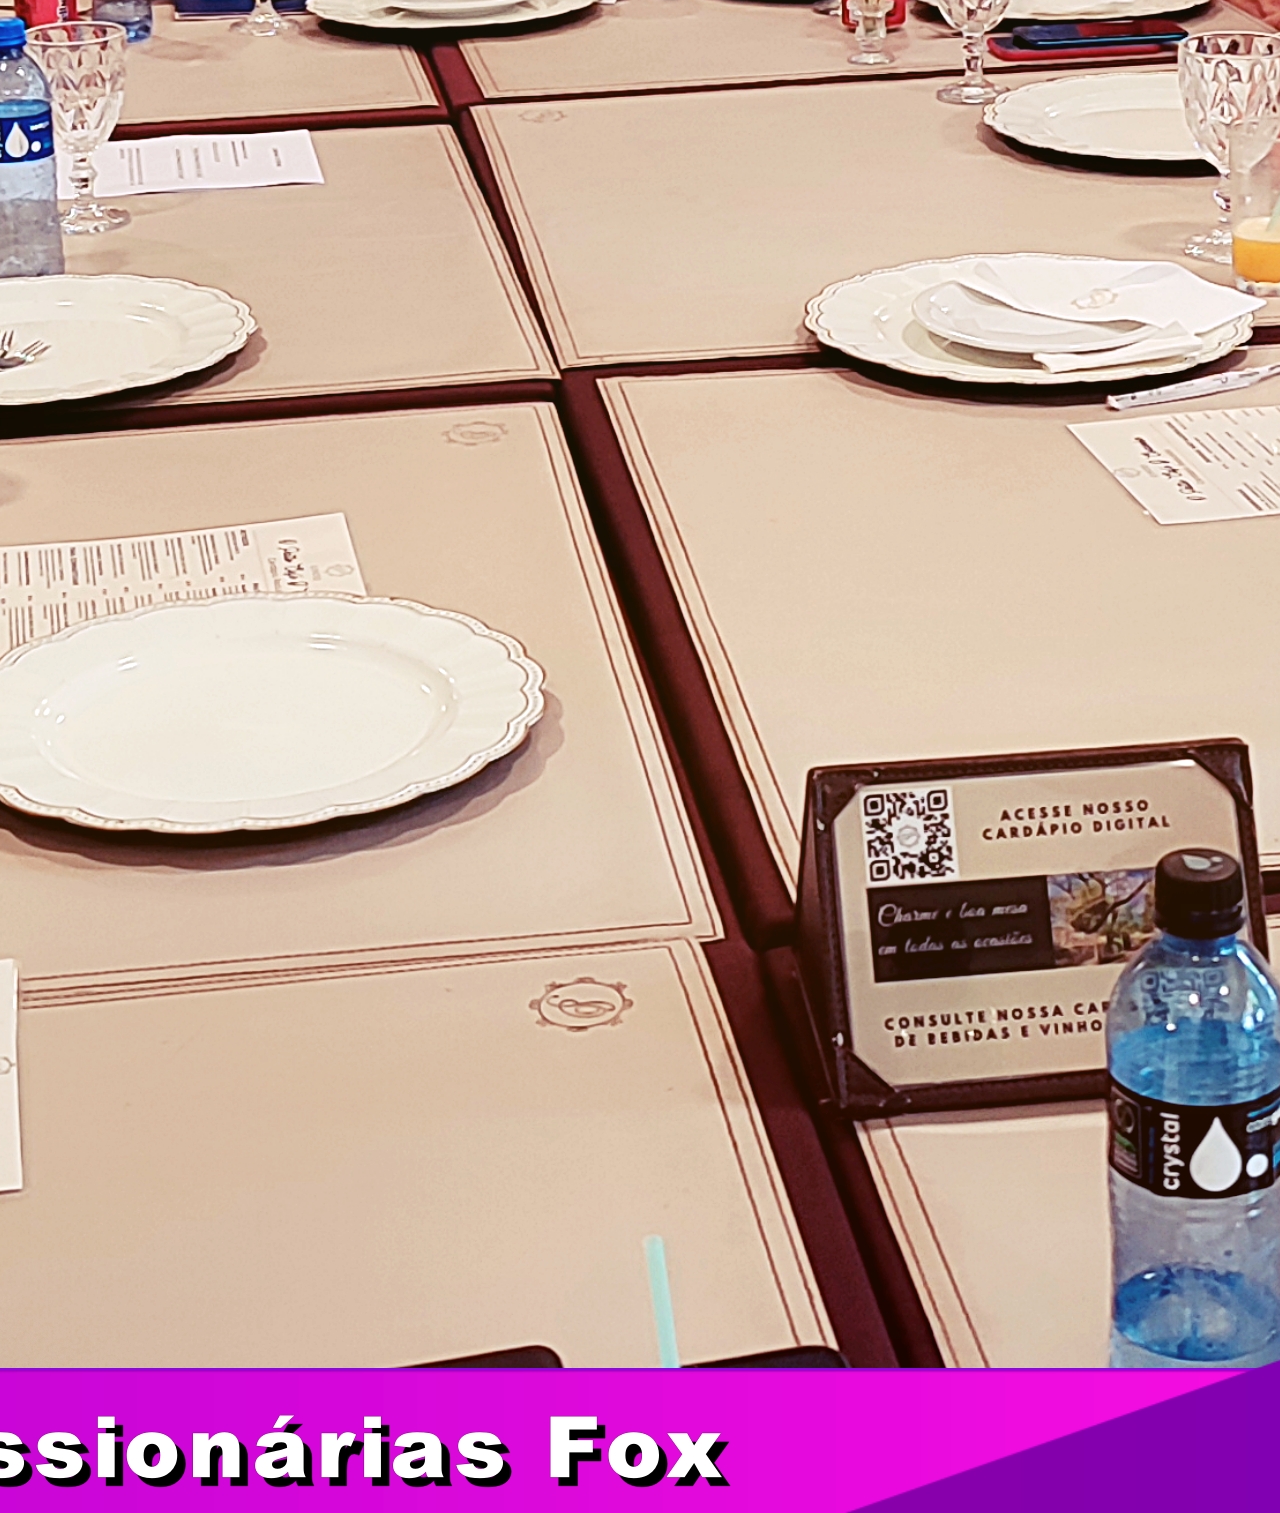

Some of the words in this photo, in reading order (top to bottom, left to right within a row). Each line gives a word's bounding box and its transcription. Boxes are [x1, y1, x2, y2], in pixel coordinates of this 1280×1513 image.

[1000, 805, 1072, 821] ACESSE
[1083, 799, 1149, 815] NOSSO
[982, 821, 1082, 841] CARDÁPIO
[1093, 815, 1171, 833] DIGITAL
[877, 903, 939, 927] Charme
[992, 903, 1028, 916] mesa
[884, 1010, 986, 1031] CONSULTE
[997, 1004, 1064, 1021] NOSSA
[894, 1034, 917, 1048] DE
[927, 1027, 1010, 1045] BEBIDAS
[1020, 1025, 1029, 1038] E
[1159, 1111, 1185, 1191] crystal
